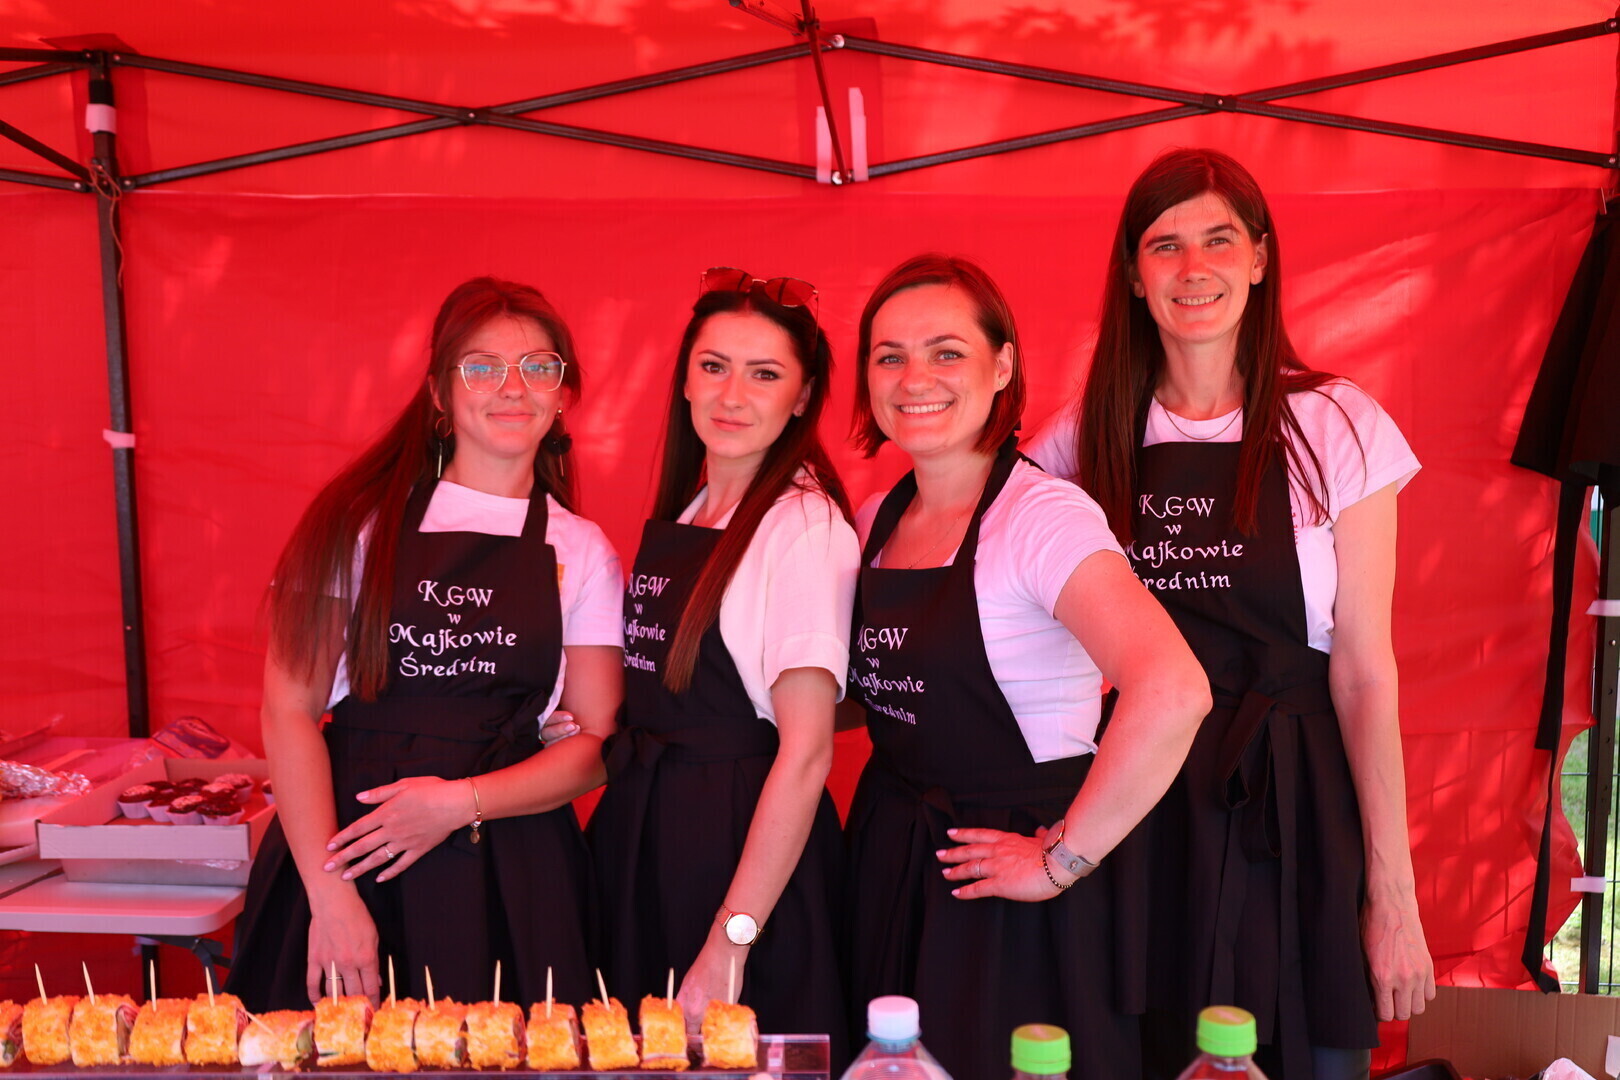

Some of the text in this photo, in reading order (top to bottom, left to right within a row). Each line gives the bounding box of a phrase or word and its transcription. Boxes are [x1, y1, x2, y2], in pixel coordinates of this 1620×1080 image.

[1138, 494, 1215, 519] KGW
[1164, 524, 1182, 536] w
[1131, 565, 1231, 590] rednim
[417, 580, 493, 607] KGW
[634, 602, 644, 615] w
[447, 612, 462, 625] w
[389, 623, 518, 656] Majkowie
[865, 657, 880, 669] w
